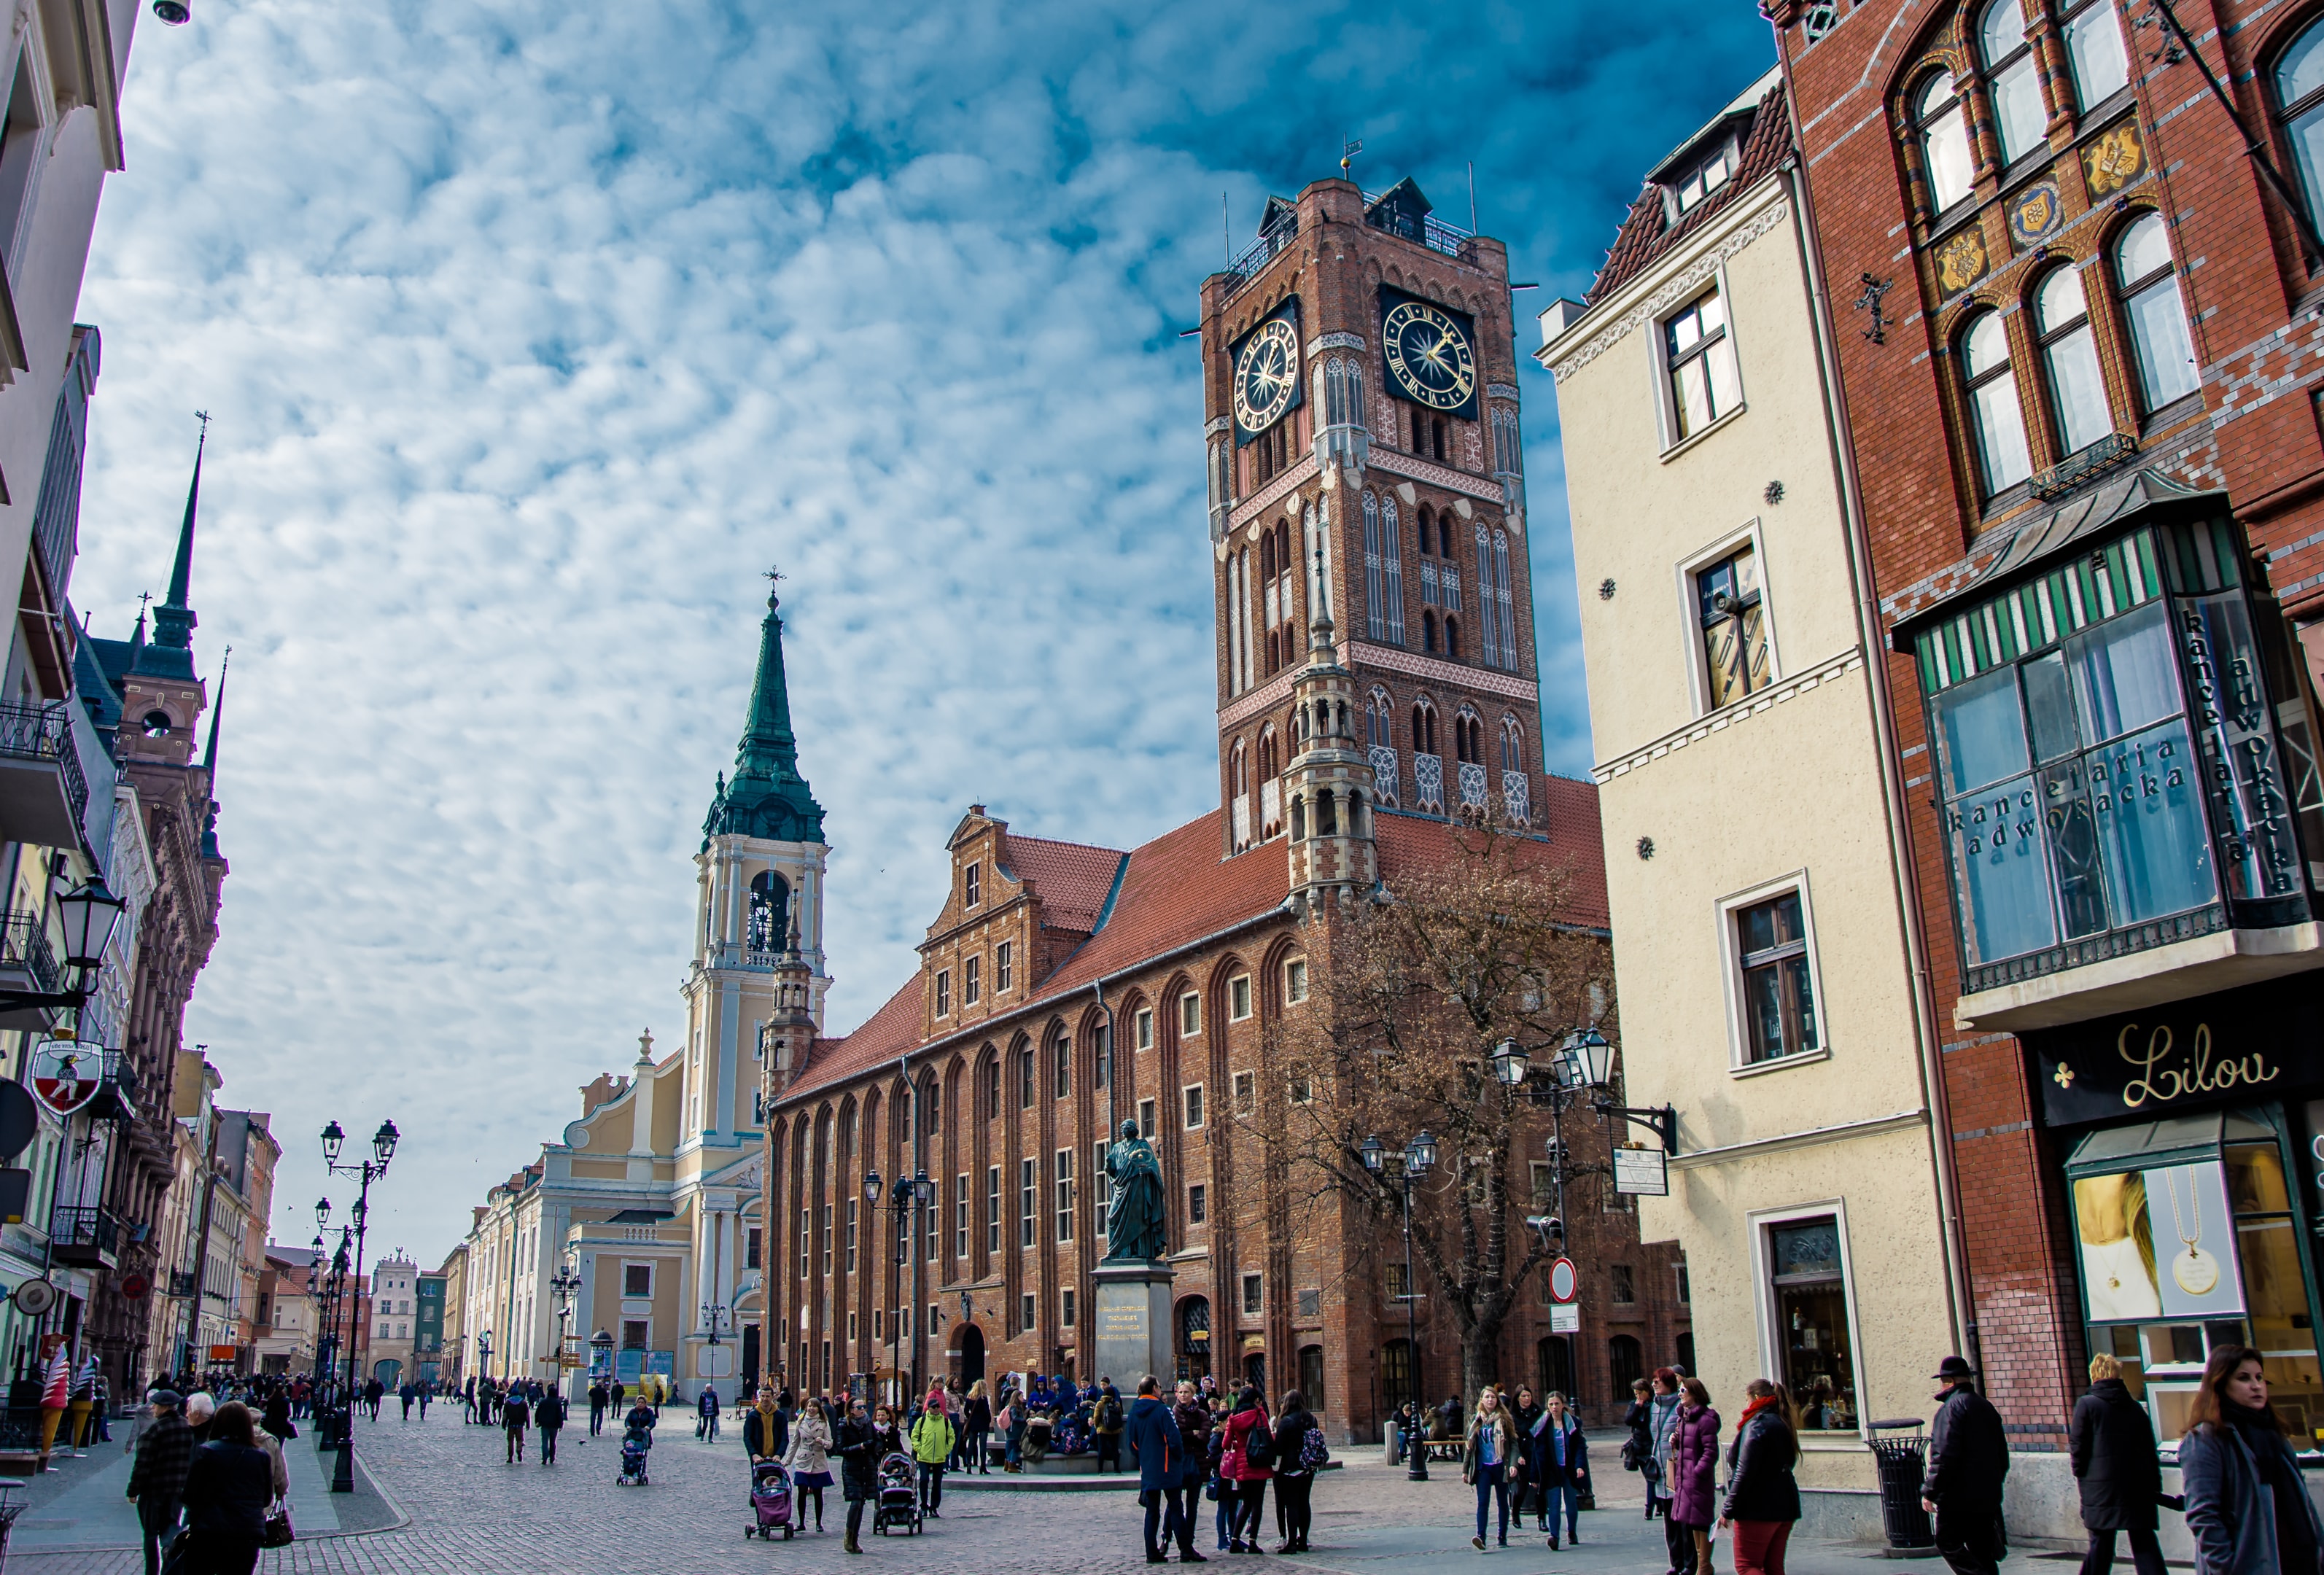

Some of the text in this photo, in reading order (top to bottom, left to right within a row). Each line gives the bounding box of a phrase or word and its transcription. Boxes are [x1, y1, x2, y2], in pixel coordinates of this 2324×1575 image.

[2183, 609, 2248, 861] kancelaria
[2230, 658, 2294, 892] adwokacka
[1948, 740, 2176, 833] kancelaria
[1967, 767, 2185, 856] adwokacka
[2118, 1023, 2280, 1108] Lilou
